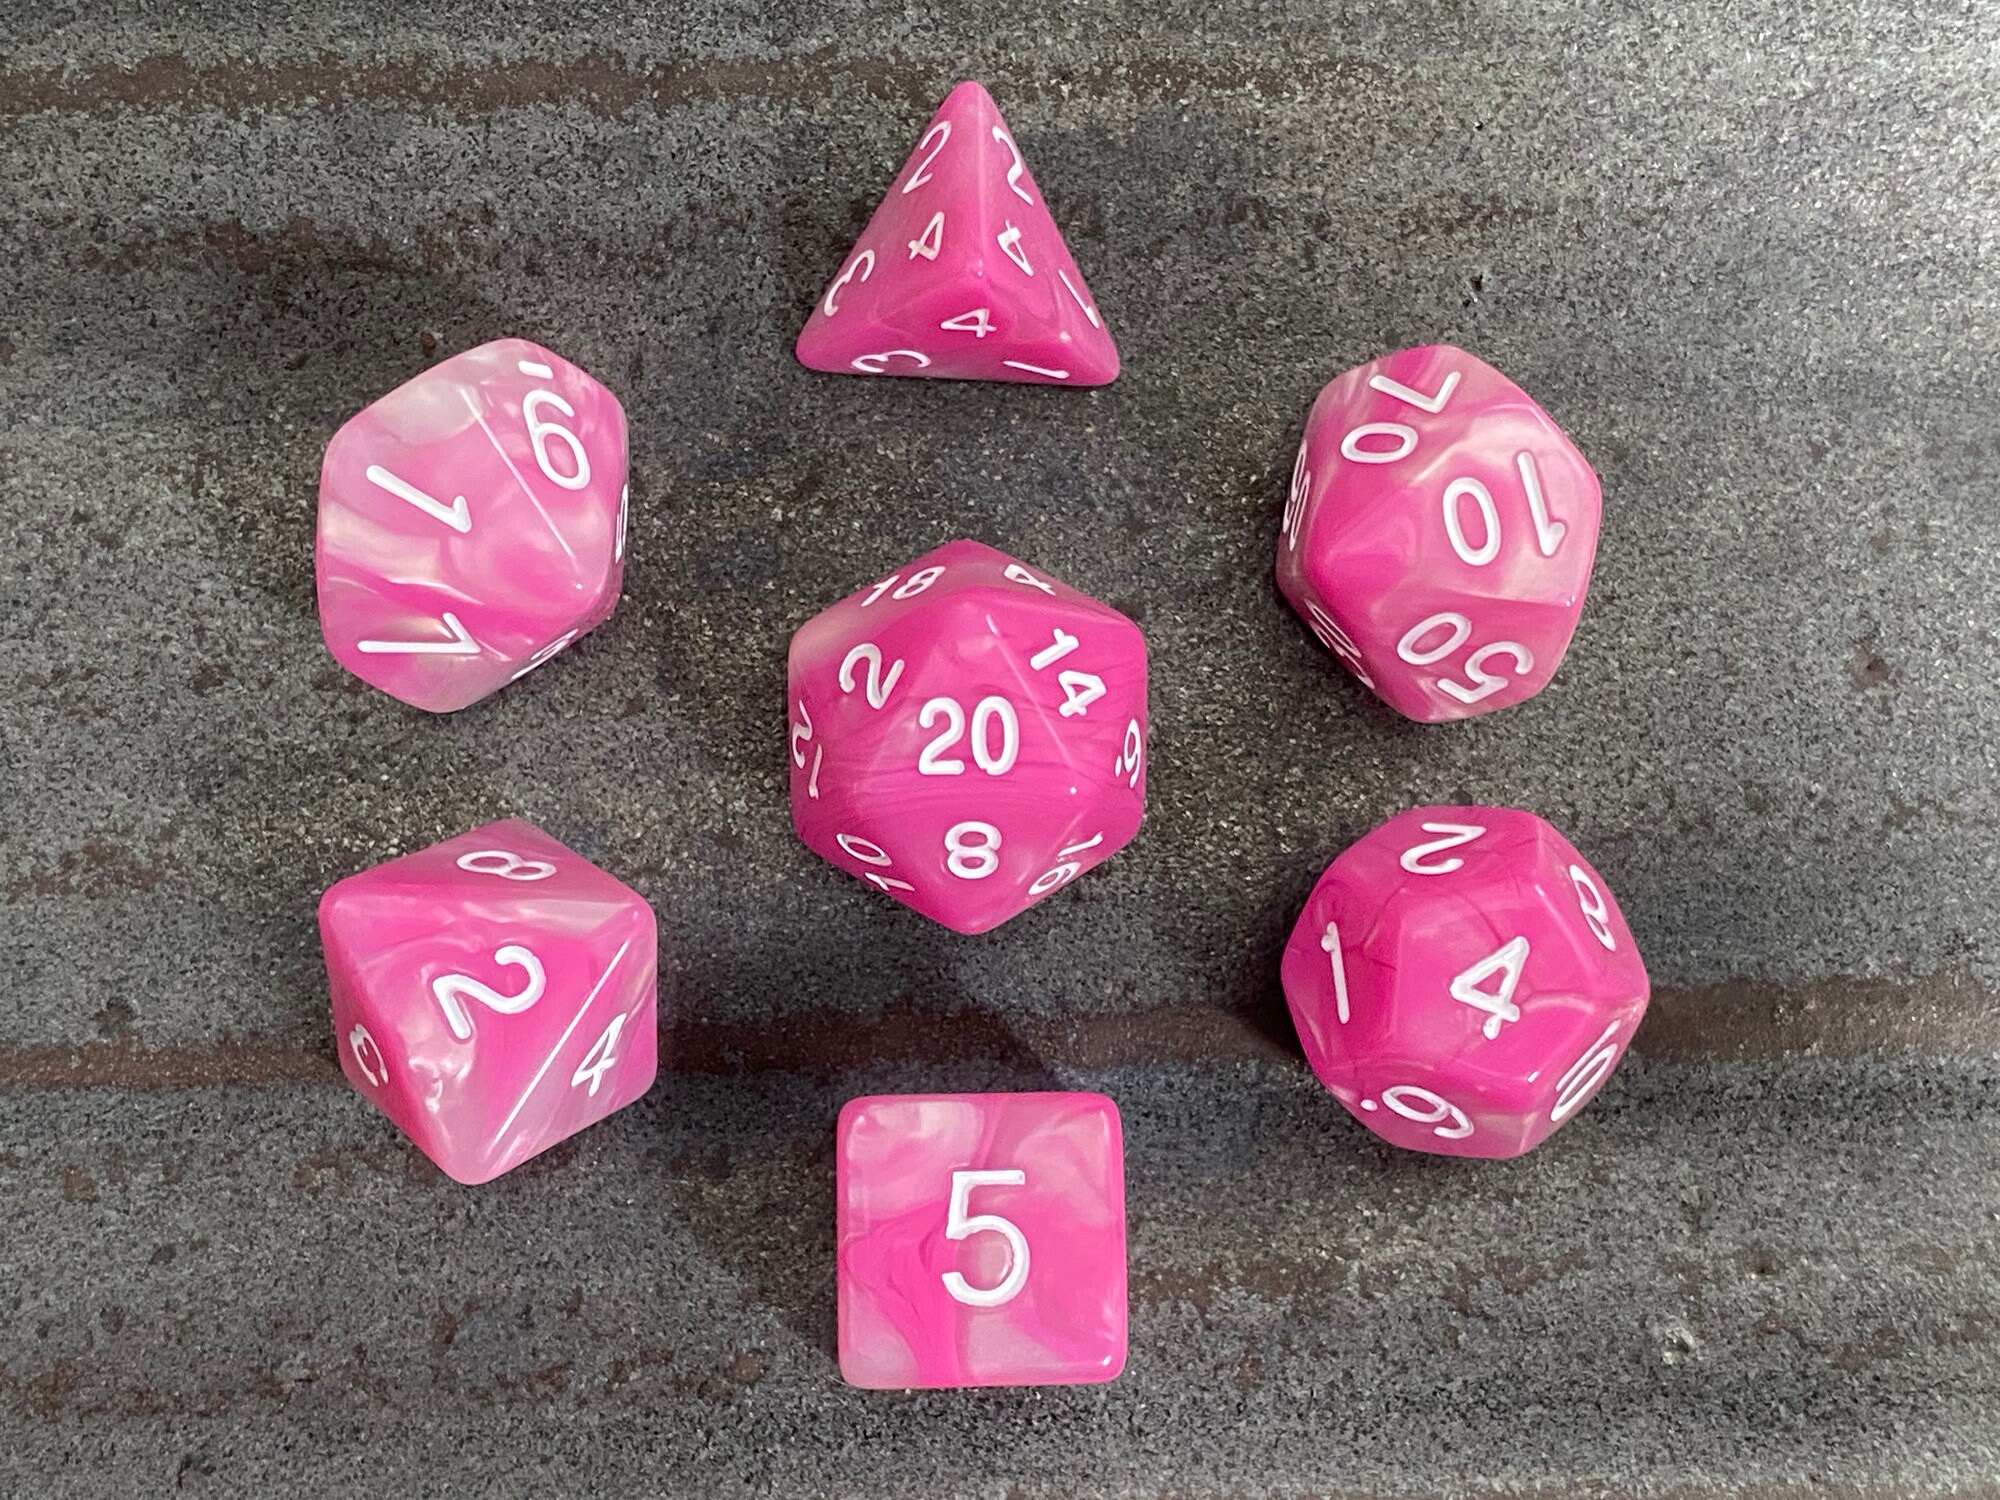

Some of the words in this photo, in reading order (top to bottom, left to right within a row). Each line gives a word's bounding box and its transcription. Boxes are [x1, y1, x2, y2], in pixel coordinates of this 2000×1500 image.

[902, 120, 951, 194] 2
[991, 126, 1034, 206] 2
[907, 211, 945, 261] 4
[997, 220, 1034, 277] 4
[823, 249, 876, 317] 3
[940, 308, 998, 338] 4
[850, 349, 932, 373] 3
[365, 464, 473, 534] 1
[1442, 450, 1567, 567] 10
[860, 565, 947, 608] 18
[838, 642, 906, 711] 2
[1030, 627, 1107, 718] 14
[1396, 611, 1535, 705] 50
[917, 694, 1020, 777] 20
[455, 849, 558, 882] 8
[944, 820, 1003, 880] 8
[1399, 821, 1488, 876] 2
[1568, 863, 1617, 953] 8
[431, 944, 548, 1041] 2
[1319, 920, 1351, 1025] 1
[1449, 935, 1531, 1040] 4
[570, 1011, 629, 1098] 4
[940, 1168, 1032, 1308] 5
